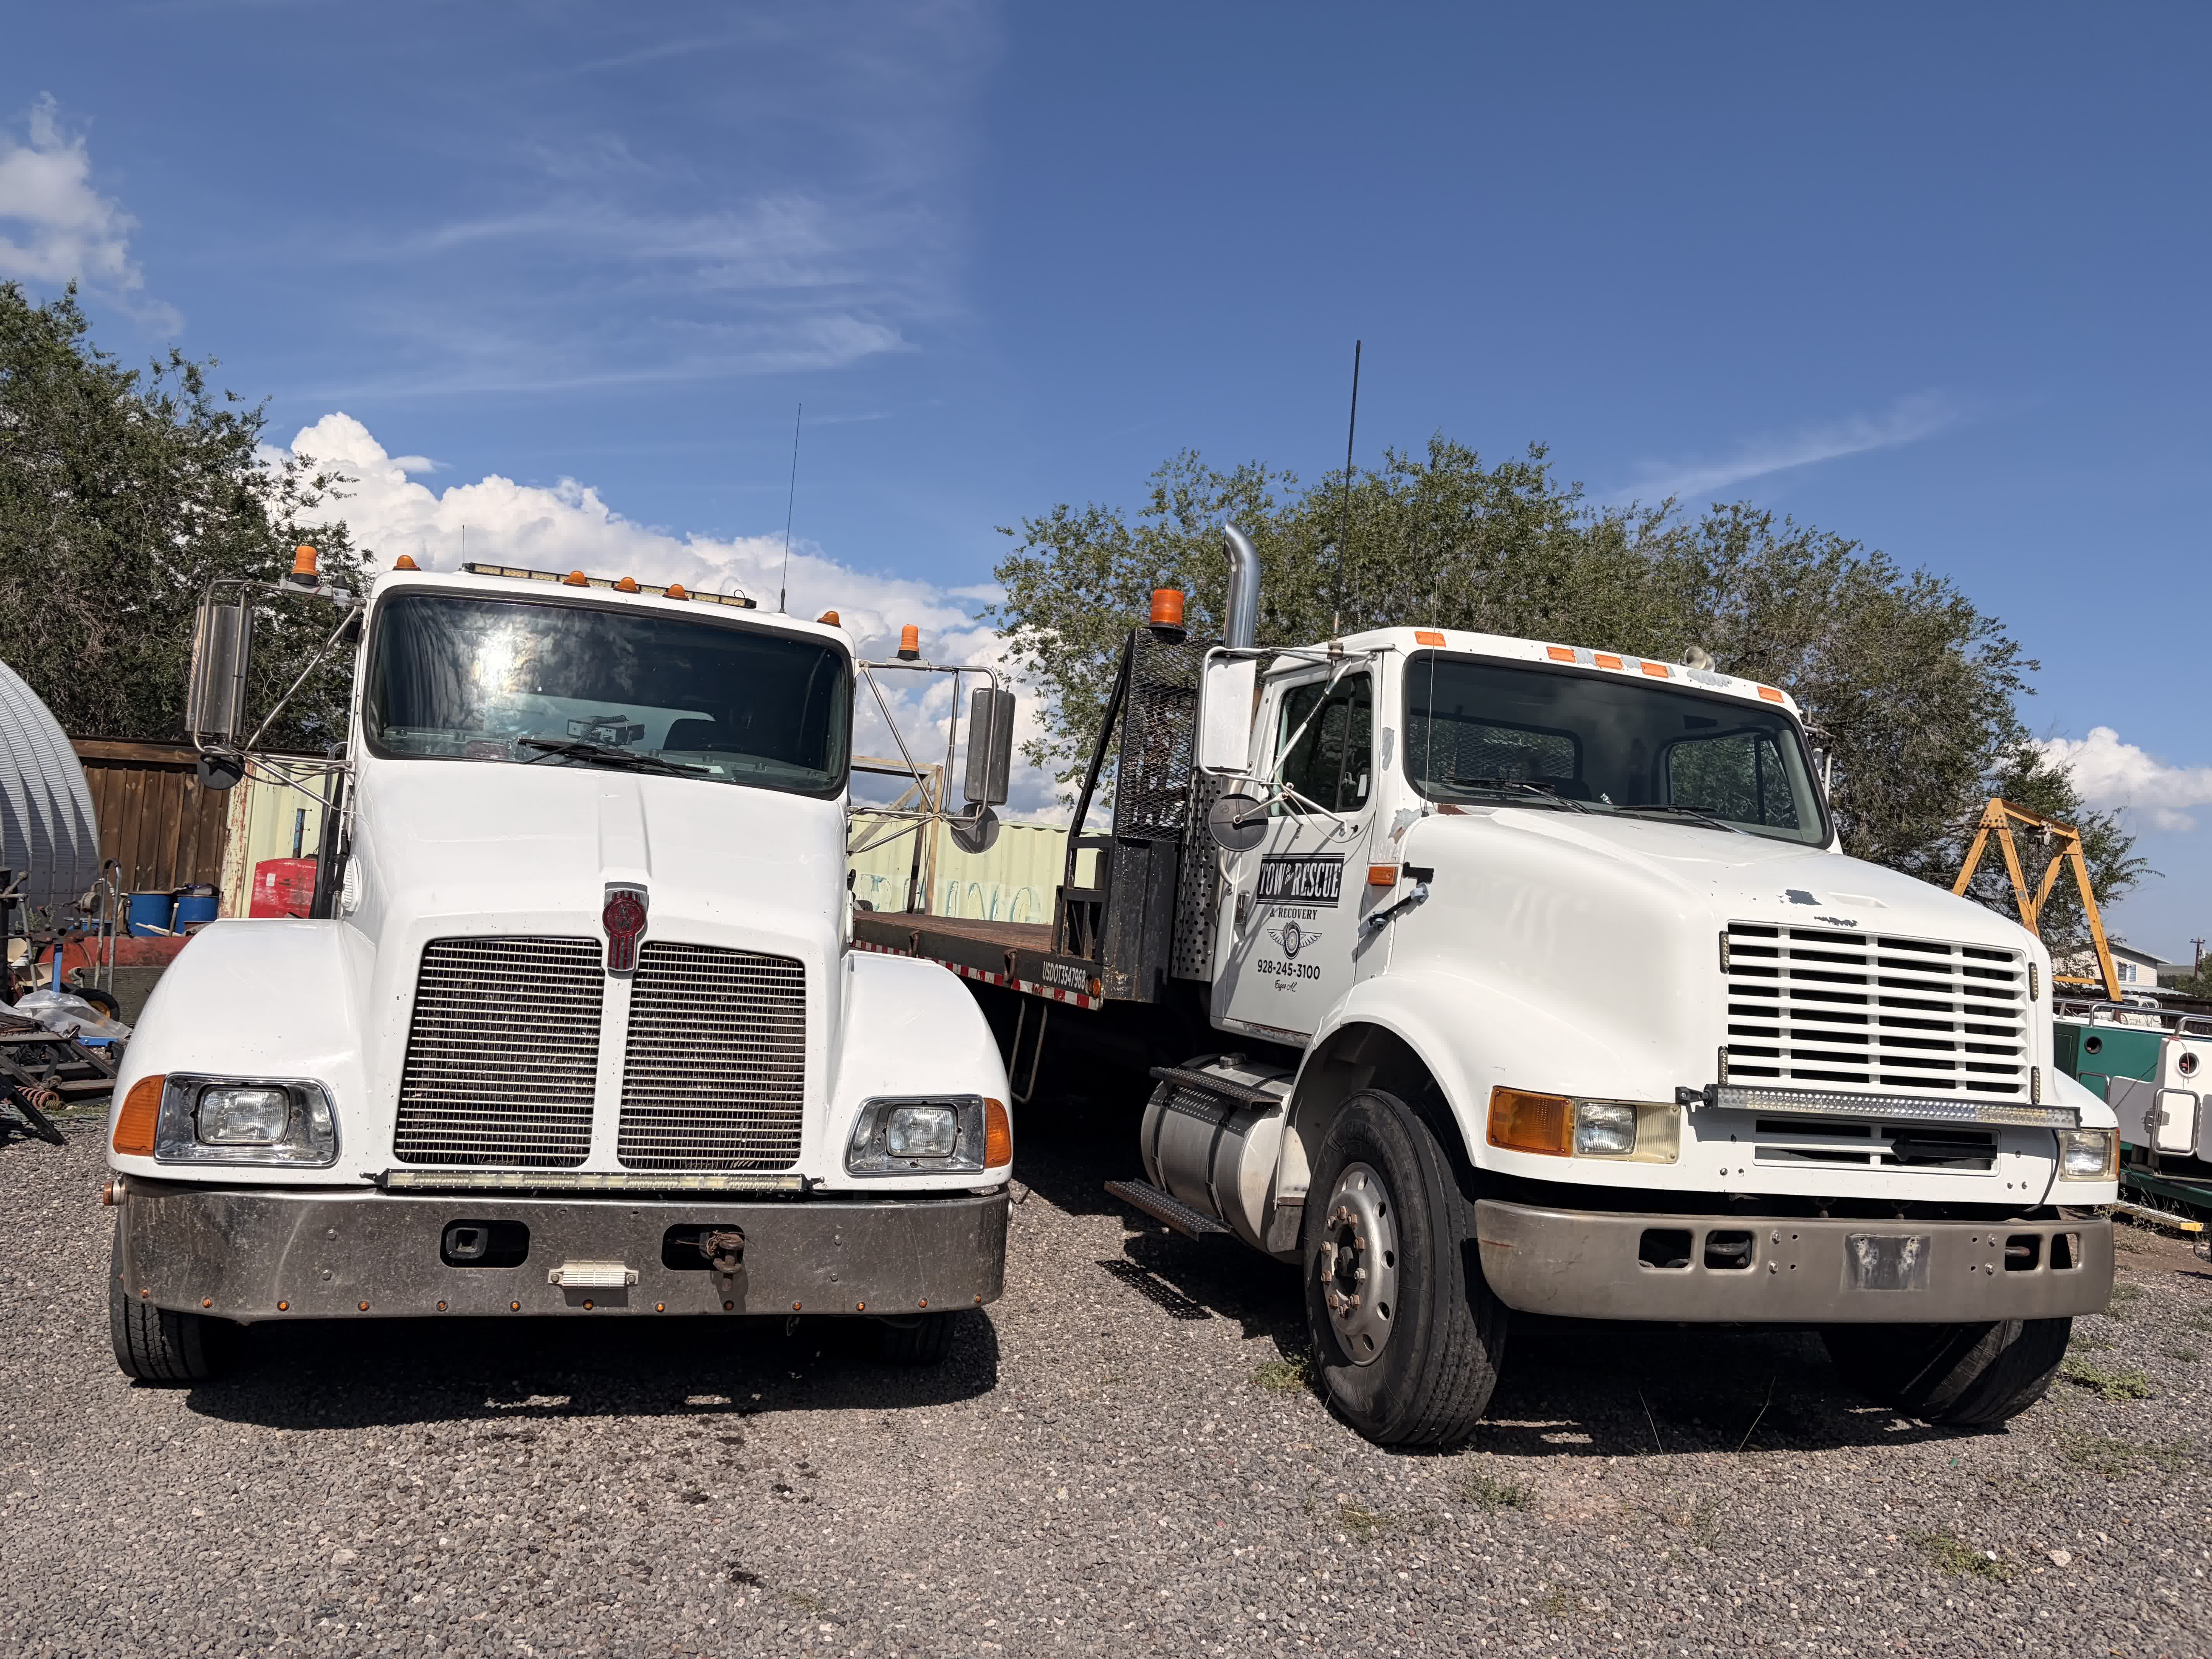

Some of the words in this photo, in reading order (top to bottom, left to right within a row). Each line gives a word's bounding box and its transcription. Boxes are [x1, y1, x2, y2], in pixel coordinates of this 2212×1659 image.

[1259, 863, 1286, 895] TOW
[1291, 862, 1342, 897] RESCUE
[1270, 907, 1275, 917] &
[1278, 908, 1317, 920] RECOVERY
[1042, 961, 1086, 990] USDOT3547968
[1258, 959, 1320, 980] 928-245-3100
